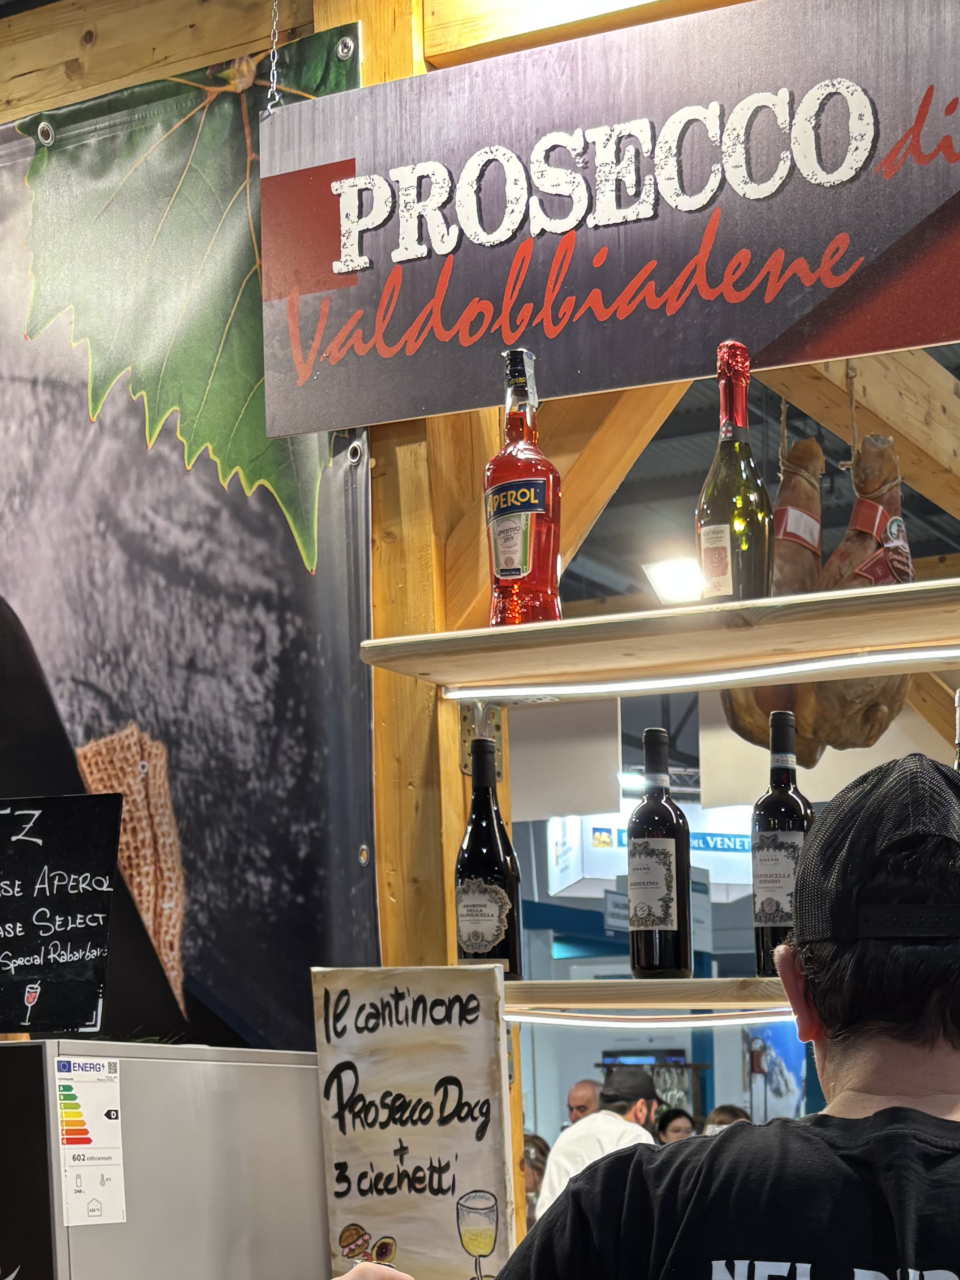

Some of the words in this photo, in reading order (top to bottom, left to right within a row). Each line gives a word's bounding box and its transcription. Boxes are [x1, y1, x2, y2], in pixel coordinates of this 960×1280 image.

[330, 77, 876, 274] PROSECCO
[284, 207, 864, 386] Valdobbiadene
[486, 487, 539, 519] APEROL
[707, 836, 750, 850] VENET
[33, 865, 114, 898] APEROL
[32, 907, 107, 937] SELECT
[354, 985, 480, 1034] cantinone
[72, 1153, 86, 1162] 602
[334, 1161, 351, 1199] 3
[357, 1152, 458, 1197] cicchetti
